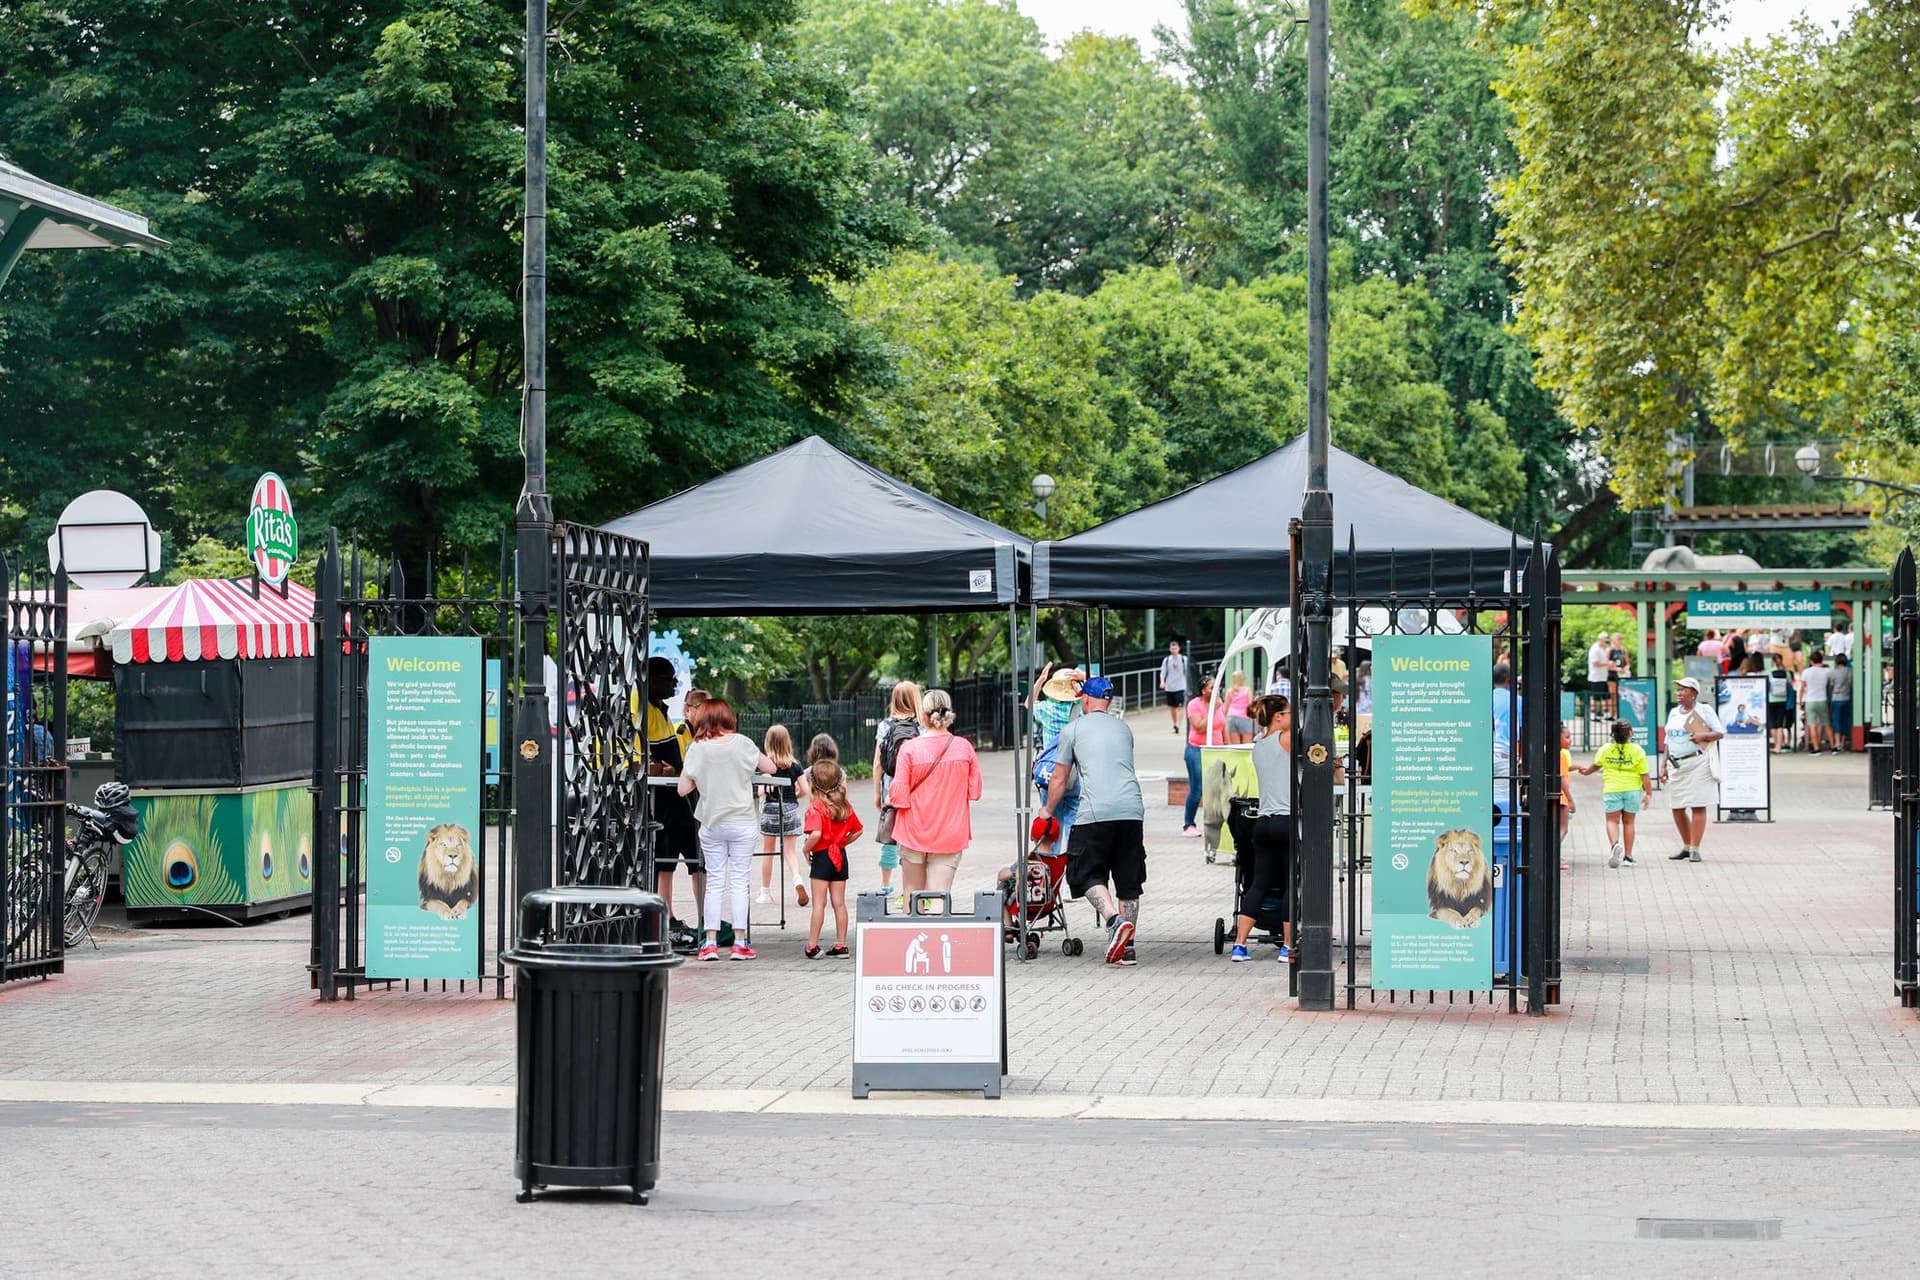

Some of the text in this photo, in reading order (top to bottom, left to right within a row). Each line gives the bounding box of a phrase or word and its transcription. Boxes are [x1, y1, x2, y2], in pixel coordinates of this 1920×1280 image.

[254, 506, 293, 549] Rita's
[1697, 599, 1821, 614] Express Ticket Sales
[386, 657, 461, 672] Welcome
[1391, 656, 1470, 672] Welcome
[386, 681, 456, 689] We've glad you brought
[1391, 681, 1465, 689] We've glad you brought
